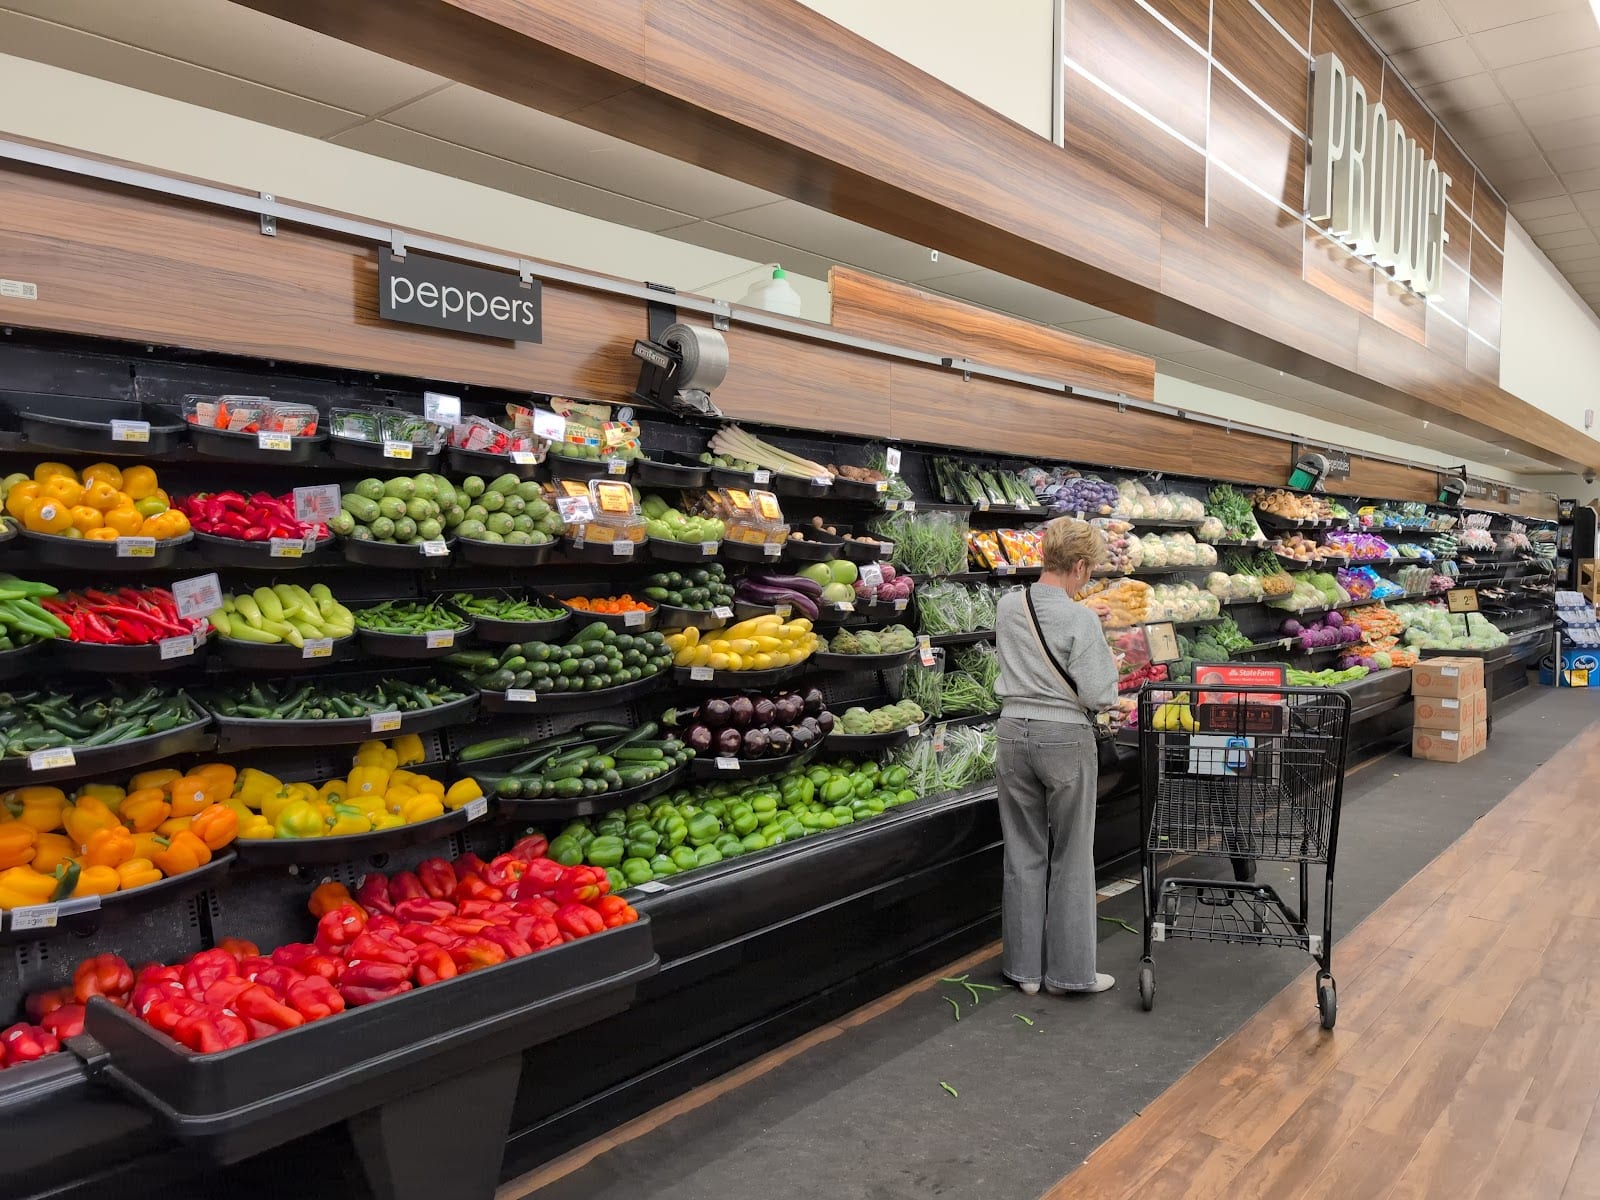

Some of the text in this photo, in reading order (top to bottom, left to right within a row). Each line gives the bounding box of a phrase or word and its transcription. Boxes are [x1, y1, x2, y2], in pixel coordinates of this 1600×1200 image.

[1311, 51, 1453, 297] PRODUCE
[390, 275, 534, 326] peppers
[1326, 458, 1350, 472] egetables
